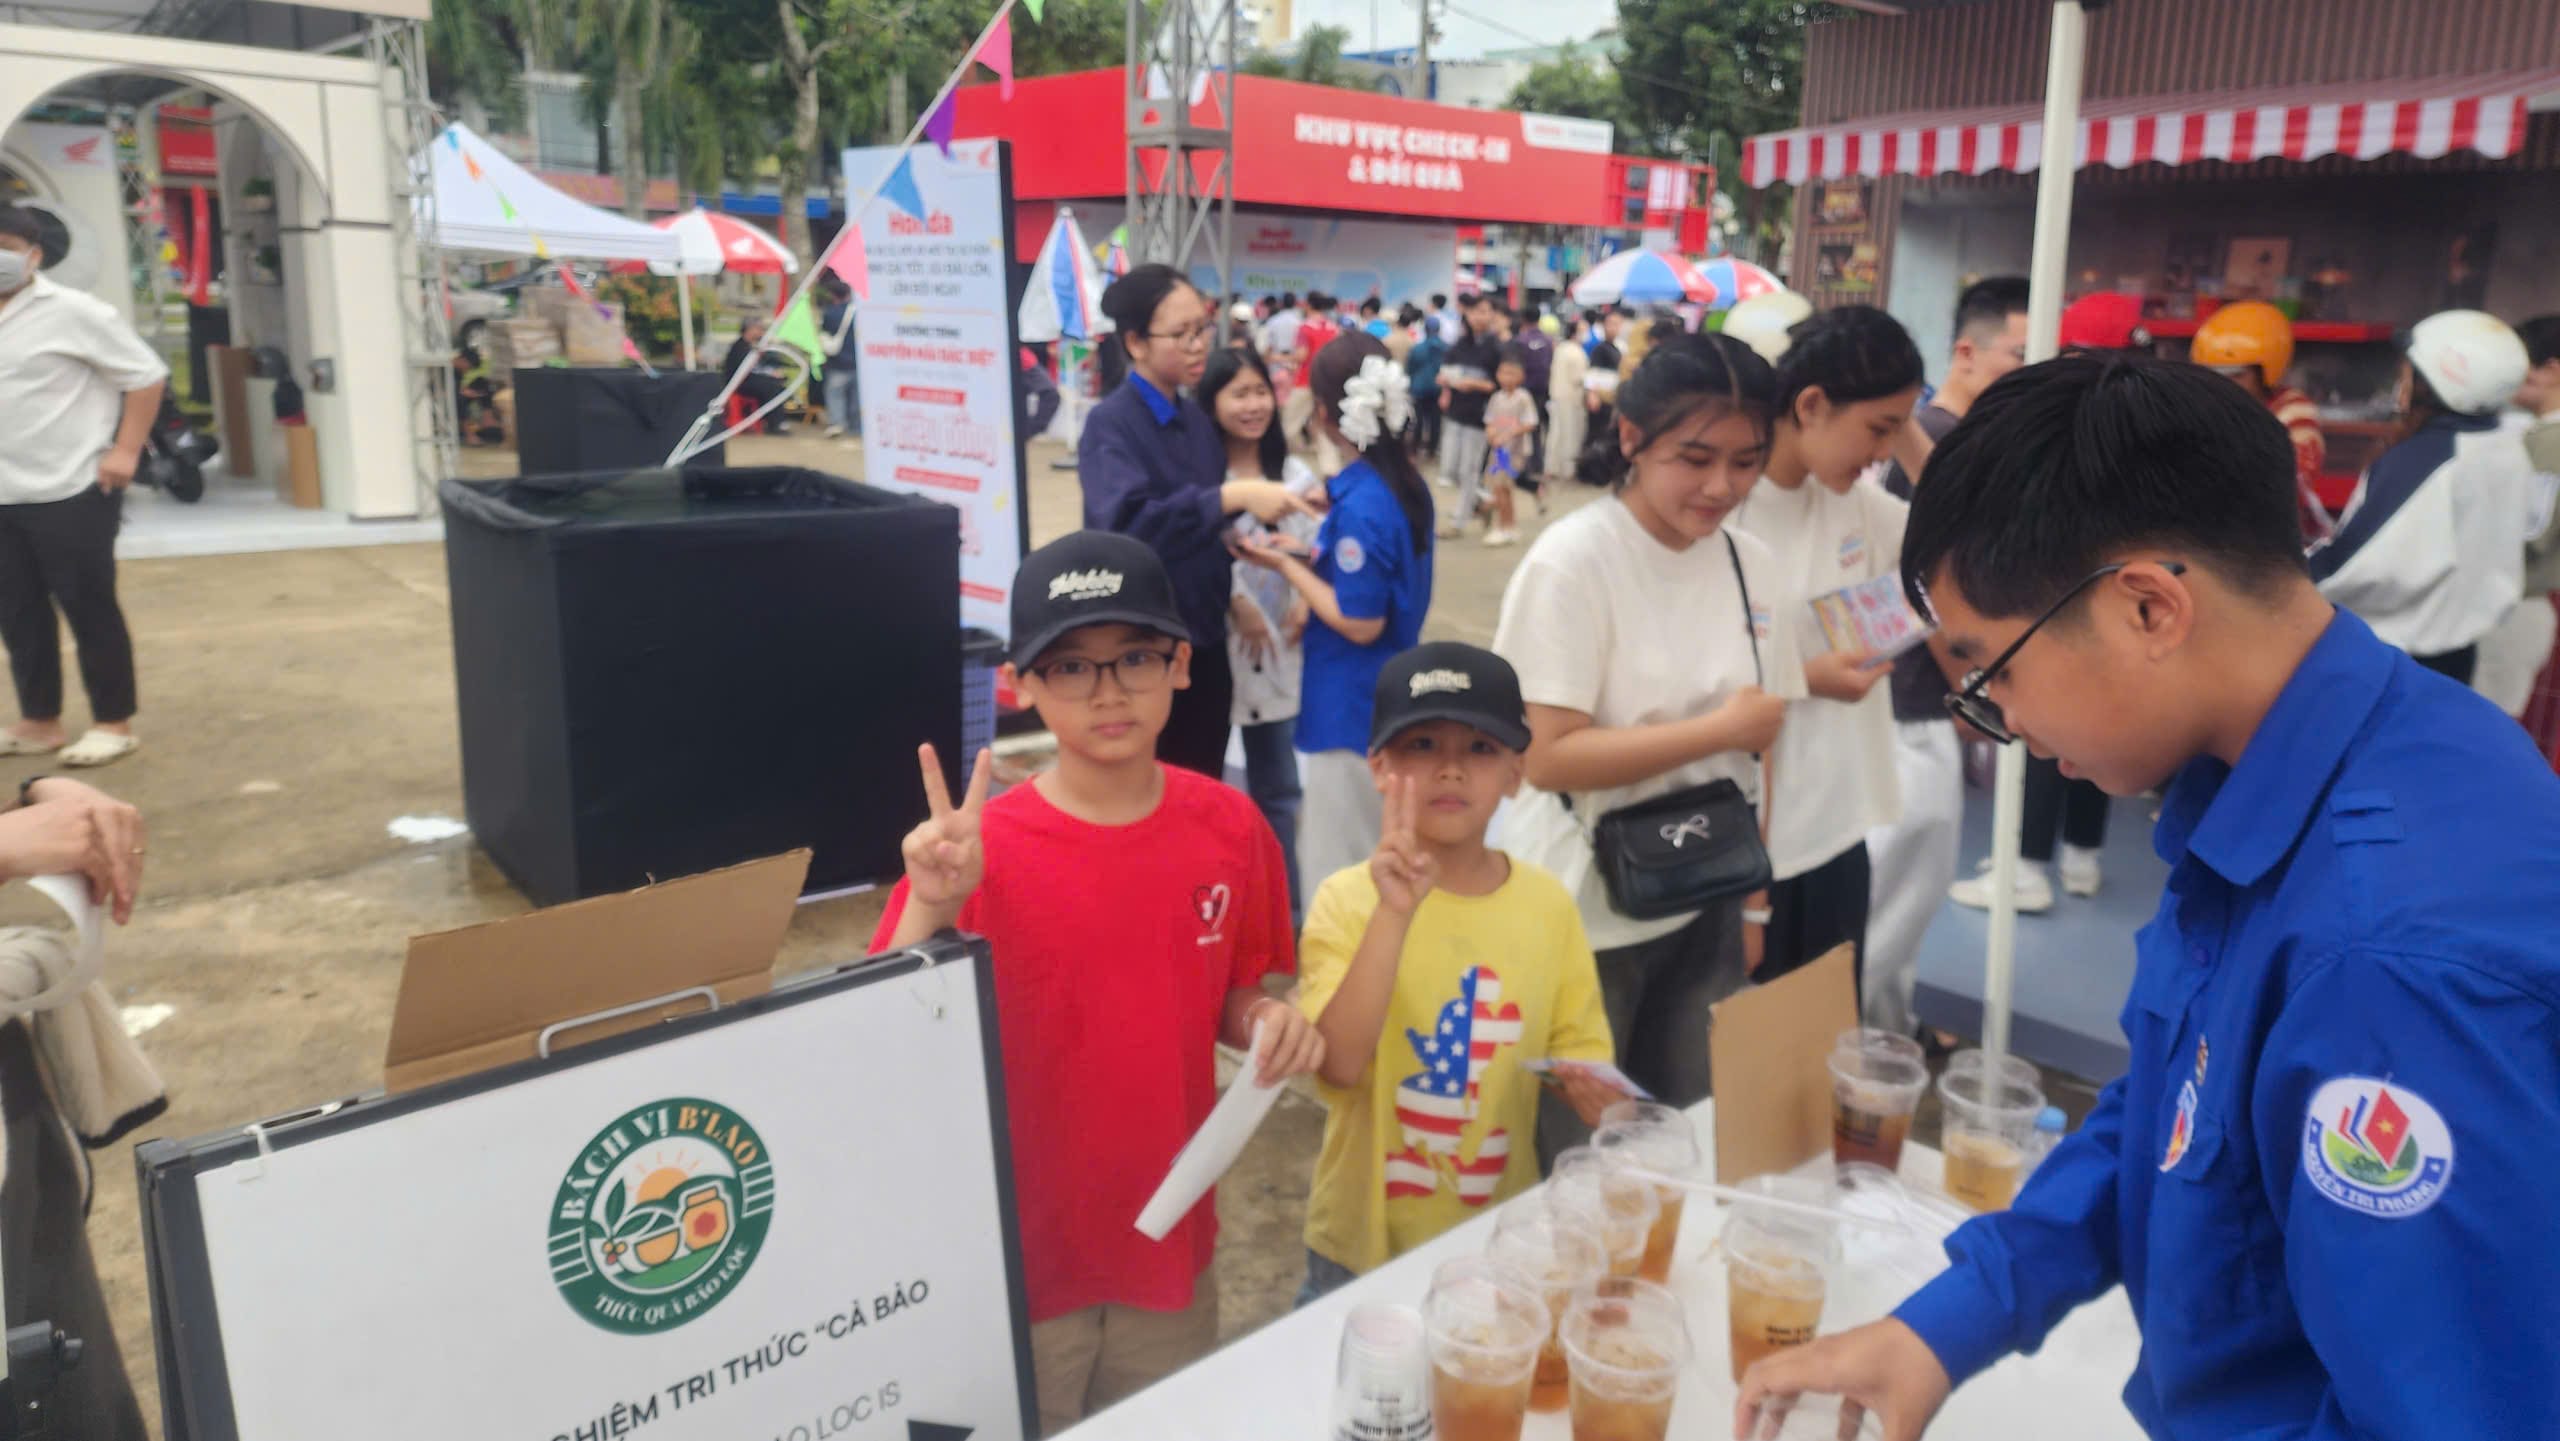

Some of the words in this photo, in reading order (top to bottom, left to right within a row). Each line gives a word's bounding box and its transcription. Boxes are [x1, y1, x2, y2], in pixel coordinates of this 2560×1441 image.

[1295, 113, 1350, 146] KHU
[1403, 127, 1511, 163] CHECK-IN
[1348, 155, 1367, 183] &
[560, 1127, 631, 1220] BÁCH
[632, 1107, 670, 1138] VỊ
[665, 1368, 716, 1409] TRI
[722, 1332, 808, 1385] THỨC
[873, 1279, 929, 1321] BẢO
[816, 1395, 873, 1440] LOC
[878, 1382, 902, 1410] IS
